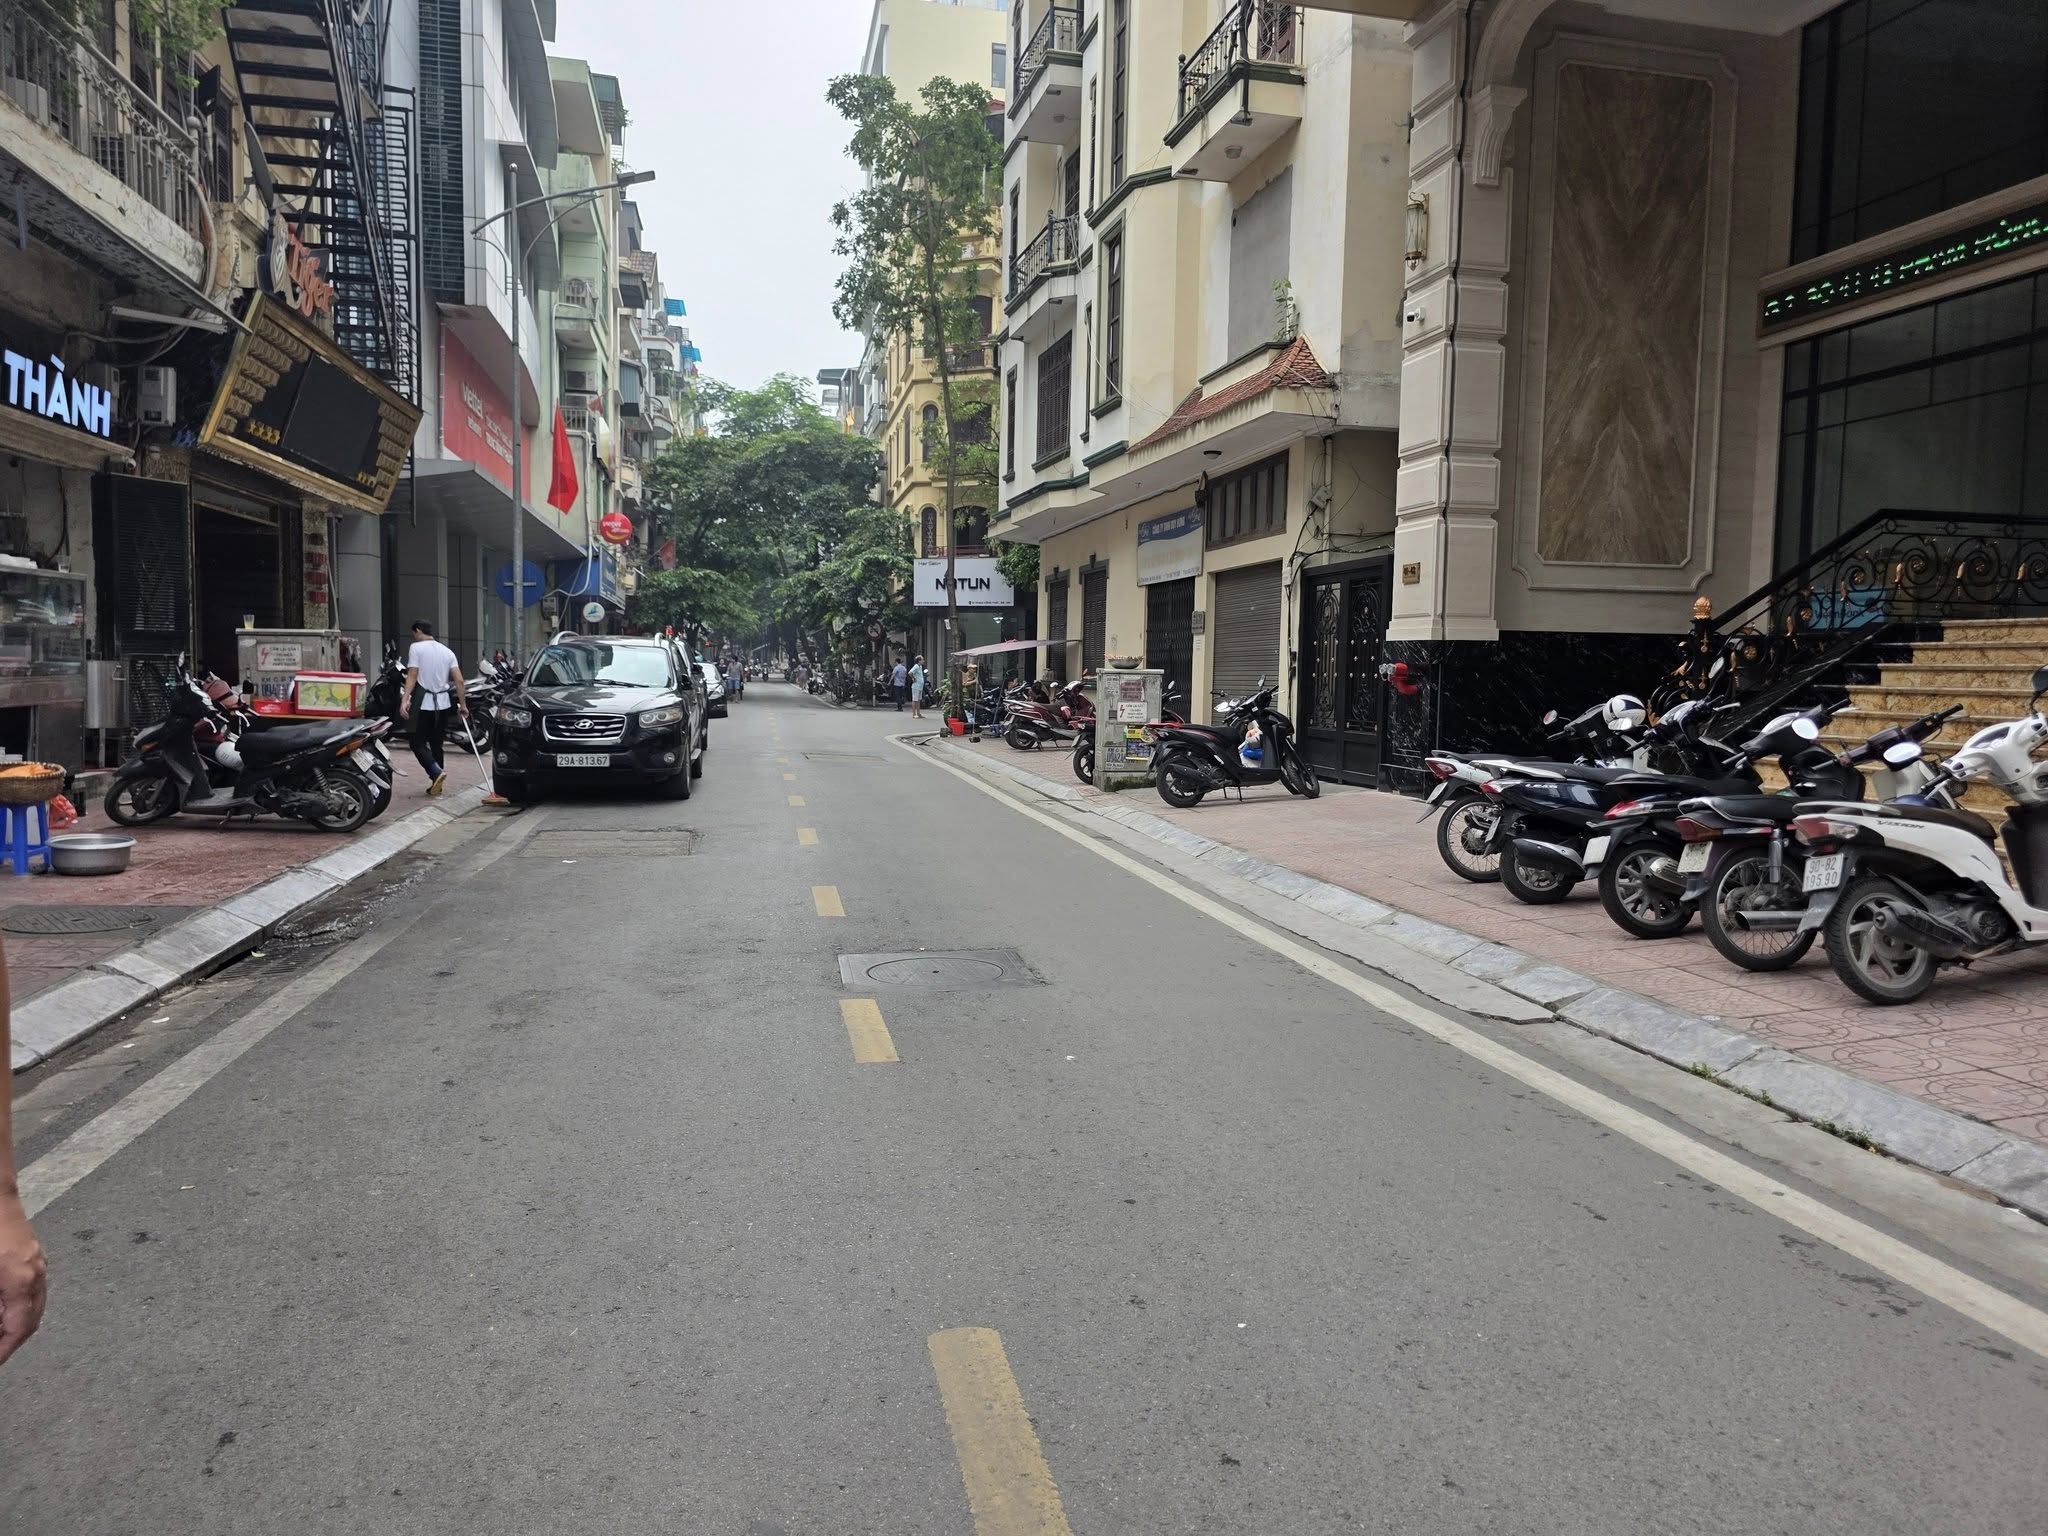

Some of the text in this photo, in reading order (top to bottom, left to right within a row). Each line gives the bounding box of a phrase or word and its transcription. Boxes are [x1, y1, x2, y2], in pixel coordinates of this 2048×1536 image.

[4, 349, 111, 437] THÀNH
[936, 577, 991, 590] NTUN
[1877, 820, 1926, 829] VISION
